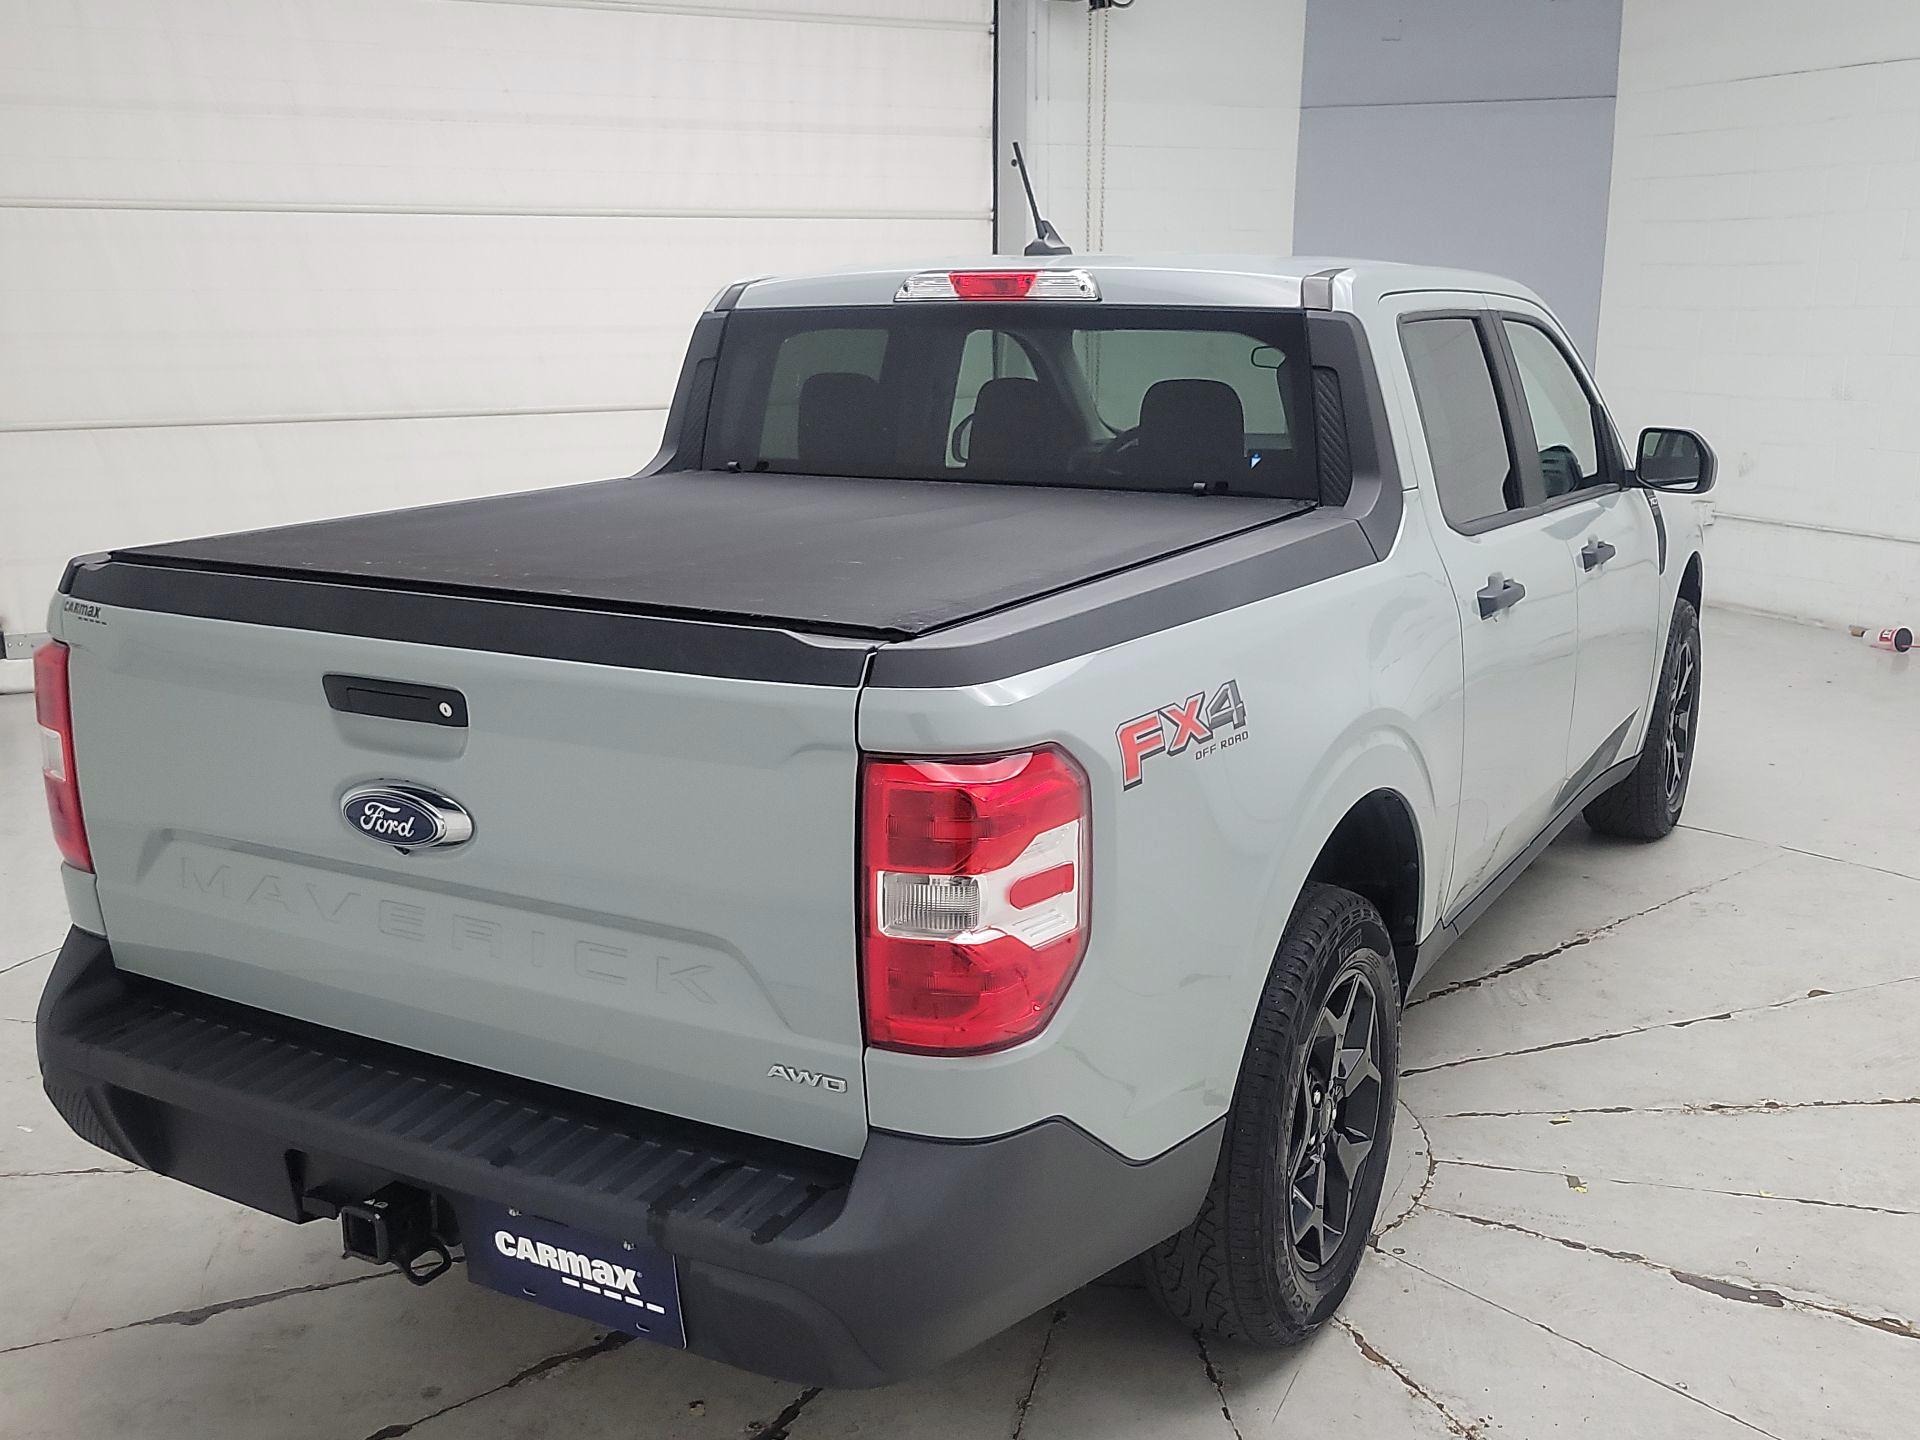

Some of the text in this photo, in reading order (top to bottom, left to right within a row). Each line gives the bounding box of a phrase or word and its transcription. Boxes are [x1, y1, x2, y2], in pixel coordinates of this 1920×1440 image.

[1115, 680, 1246, 791] FX4
[1195, 731, 1249, 760] OFF ROAD
[360, 801, 415, 838] Ford
[180, 856, 716, 1004] MAVERICK
[767, 1064, 847, 1093] AWD
